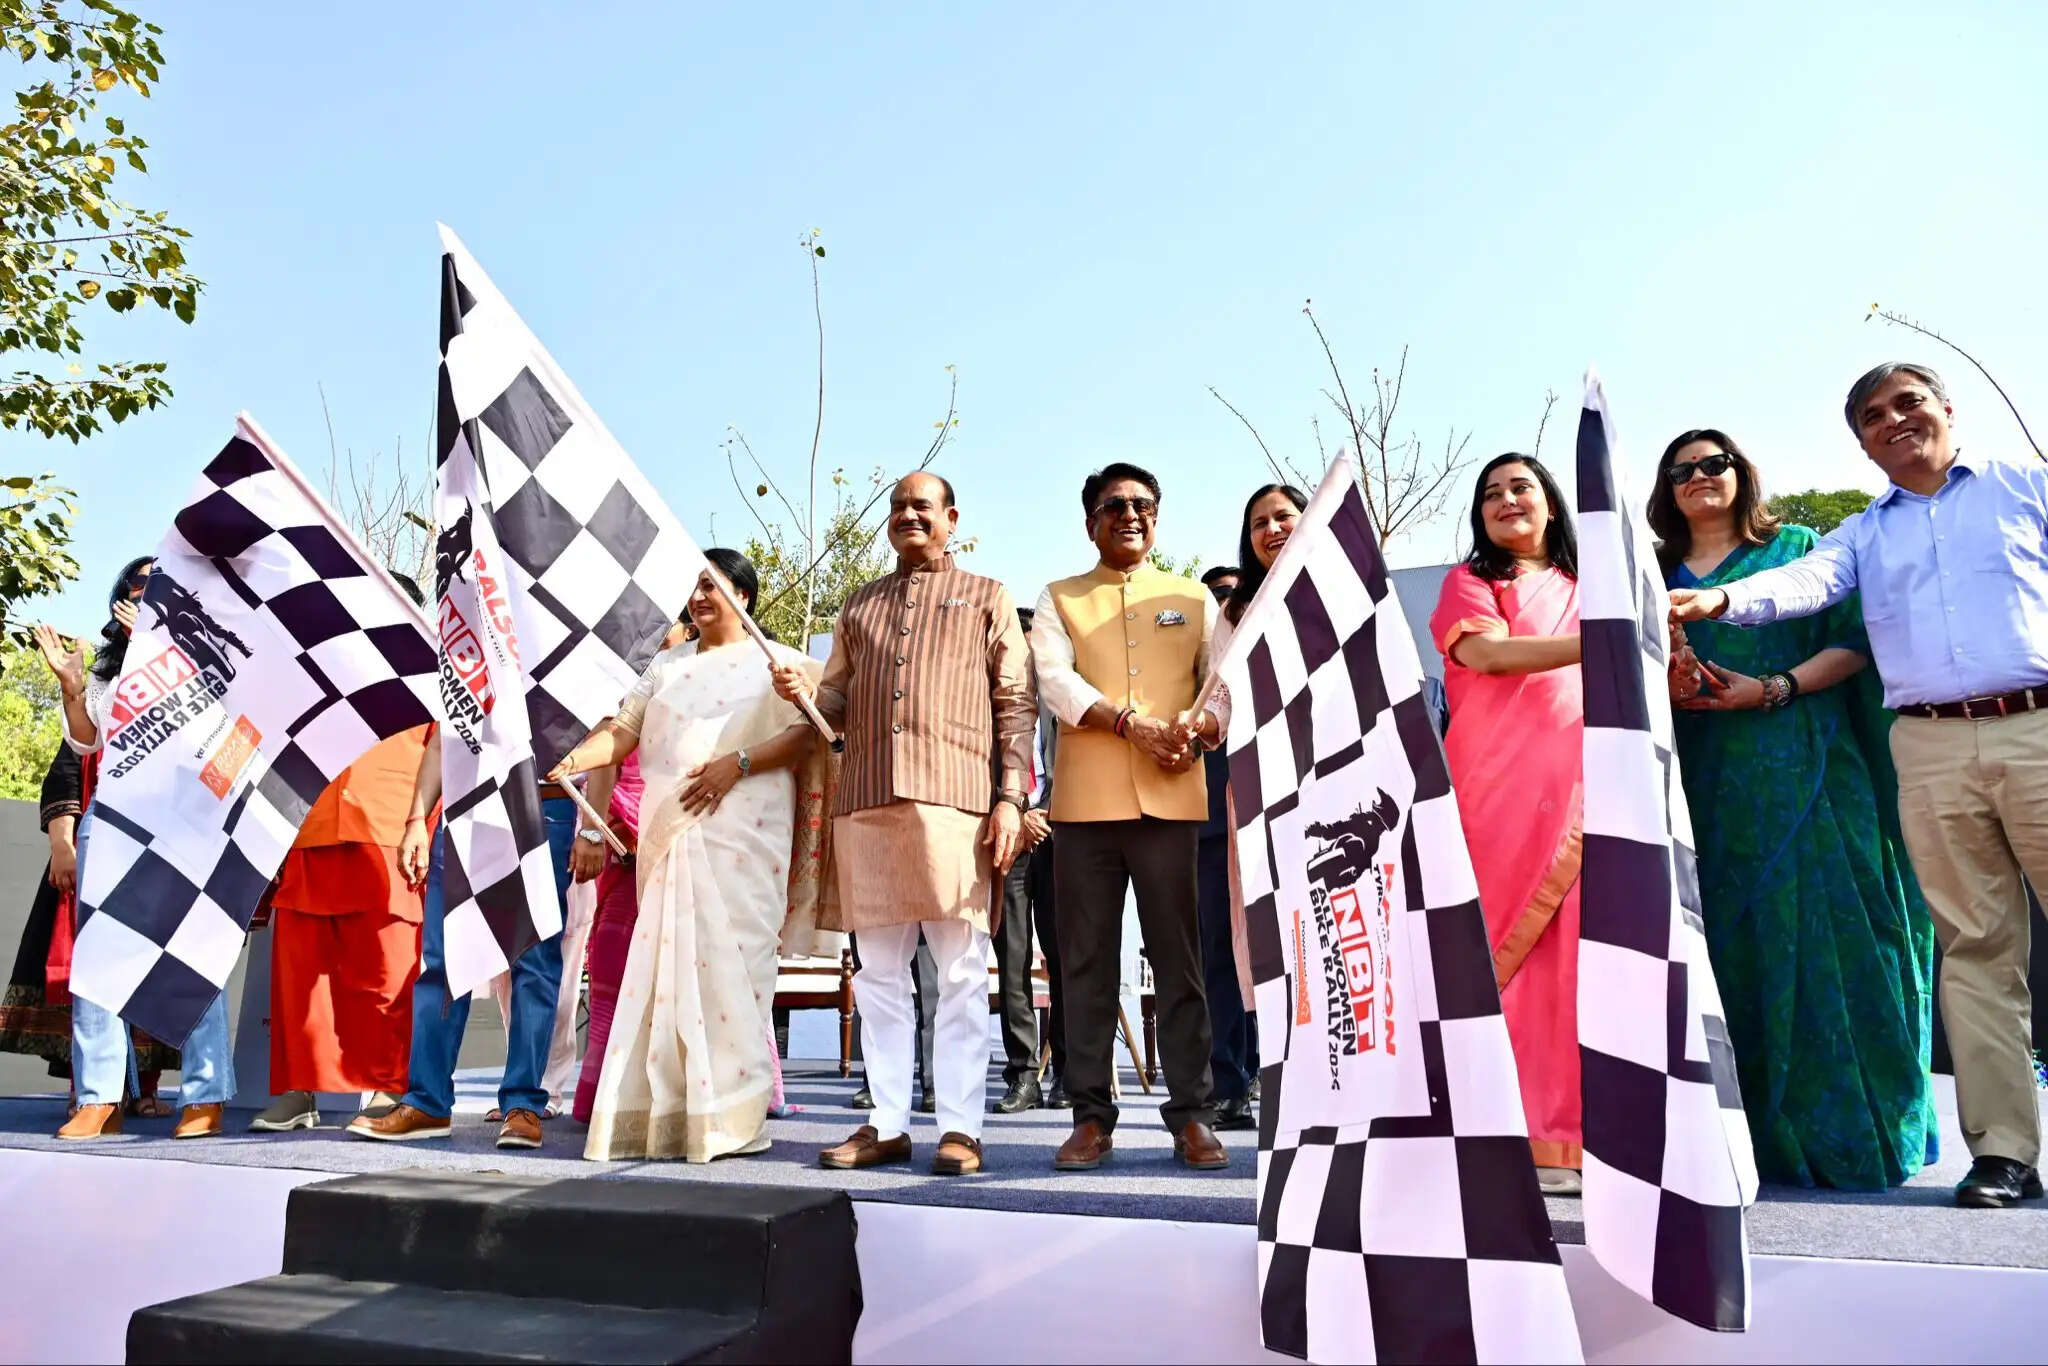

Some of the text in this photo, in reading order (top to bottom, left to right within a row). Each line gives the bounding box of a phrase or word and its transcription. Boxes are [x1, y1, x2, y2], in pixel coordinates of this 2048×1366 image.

[438, 594, 496, 716] NBT
[474, 549, 521, 672] RALSO
[439, 643, 484, 726] WOMEN
[439, 670, 483, 755] ALLY 2026
[1309, 889, 1330, 950] BIKE
[1322, 955, 1342, 1041] RALLY
[1317, 887, 1357, 1057] ALL WOMEN
[1329, 887, 1376, 1054] NBT
